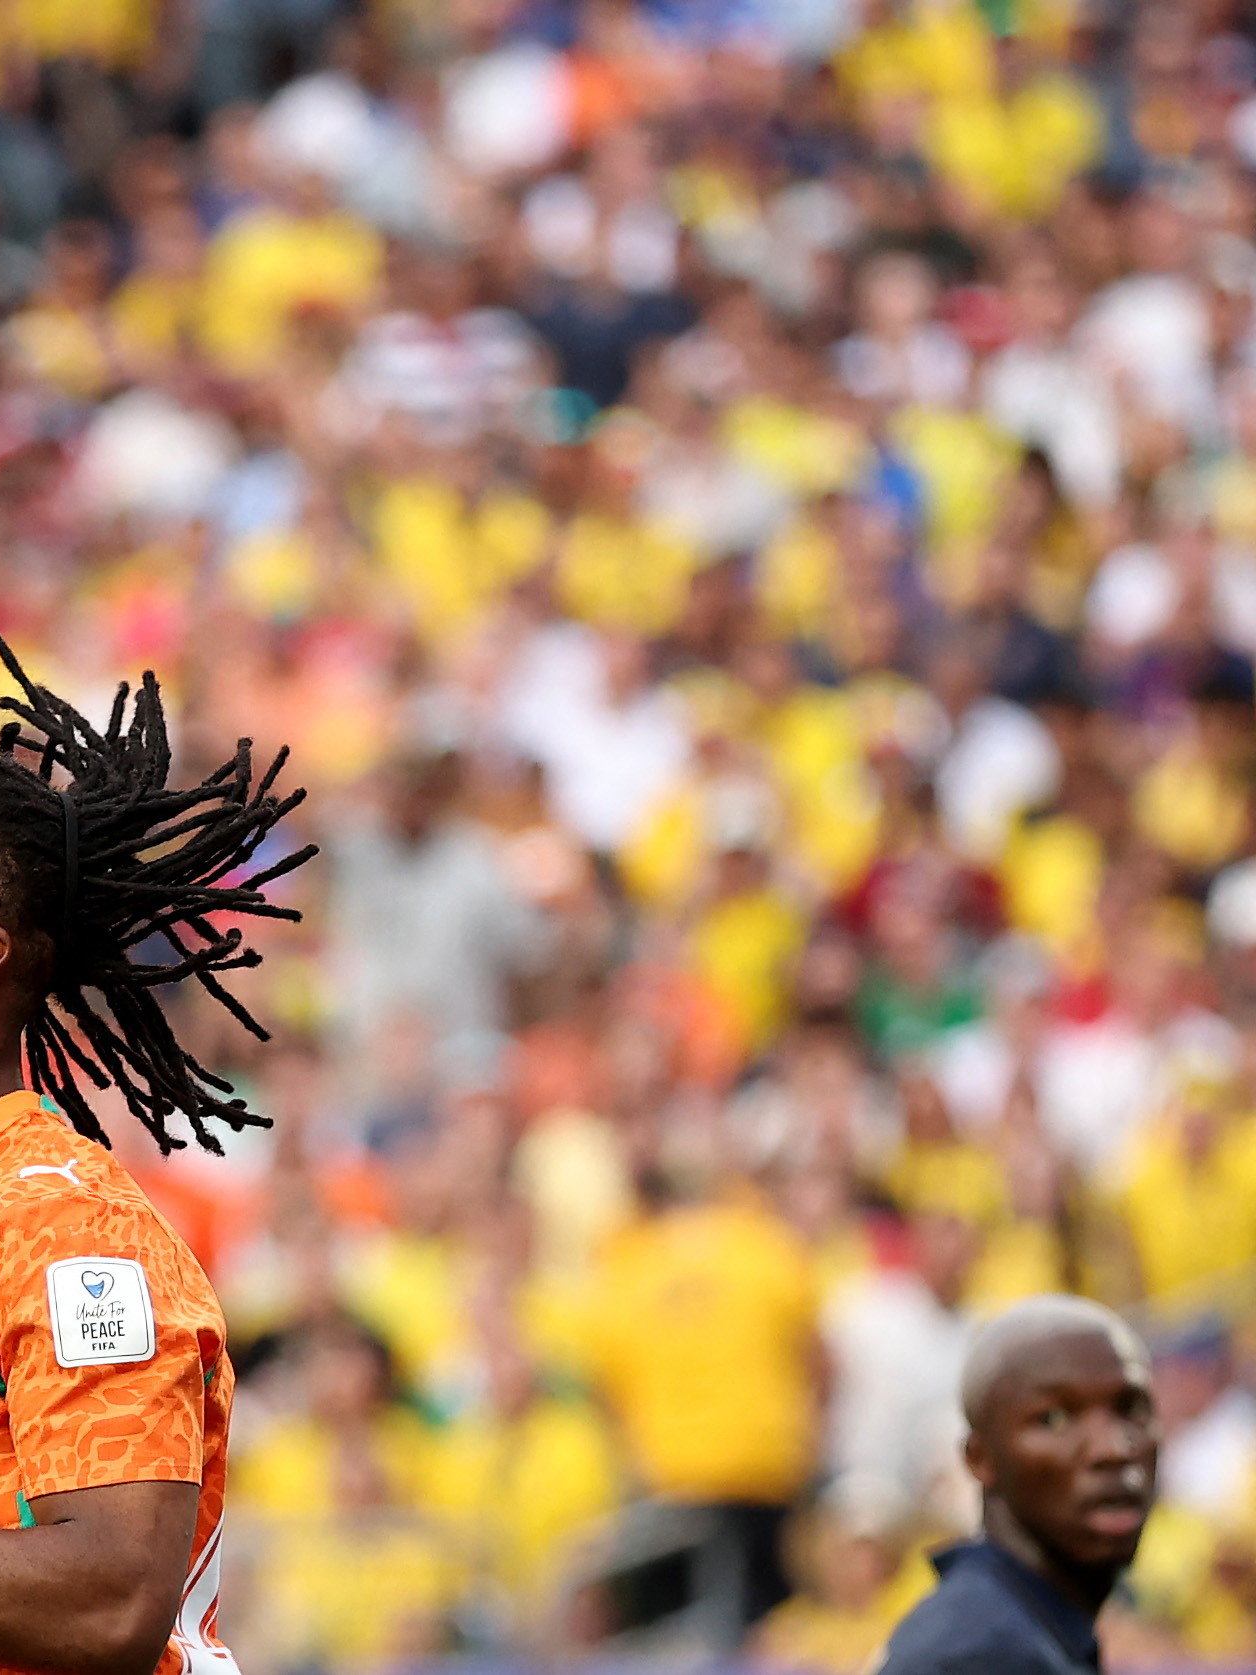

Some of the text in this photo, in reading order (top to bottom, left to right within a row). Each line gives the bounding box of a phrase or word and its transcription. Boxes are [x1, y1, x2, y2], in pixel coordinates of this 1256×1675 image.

[76, 1301, 125, 1321] Unite For
[81, 1320, 125, 1339] PEACE
[92, 1342, 116, 1351] FIFA
